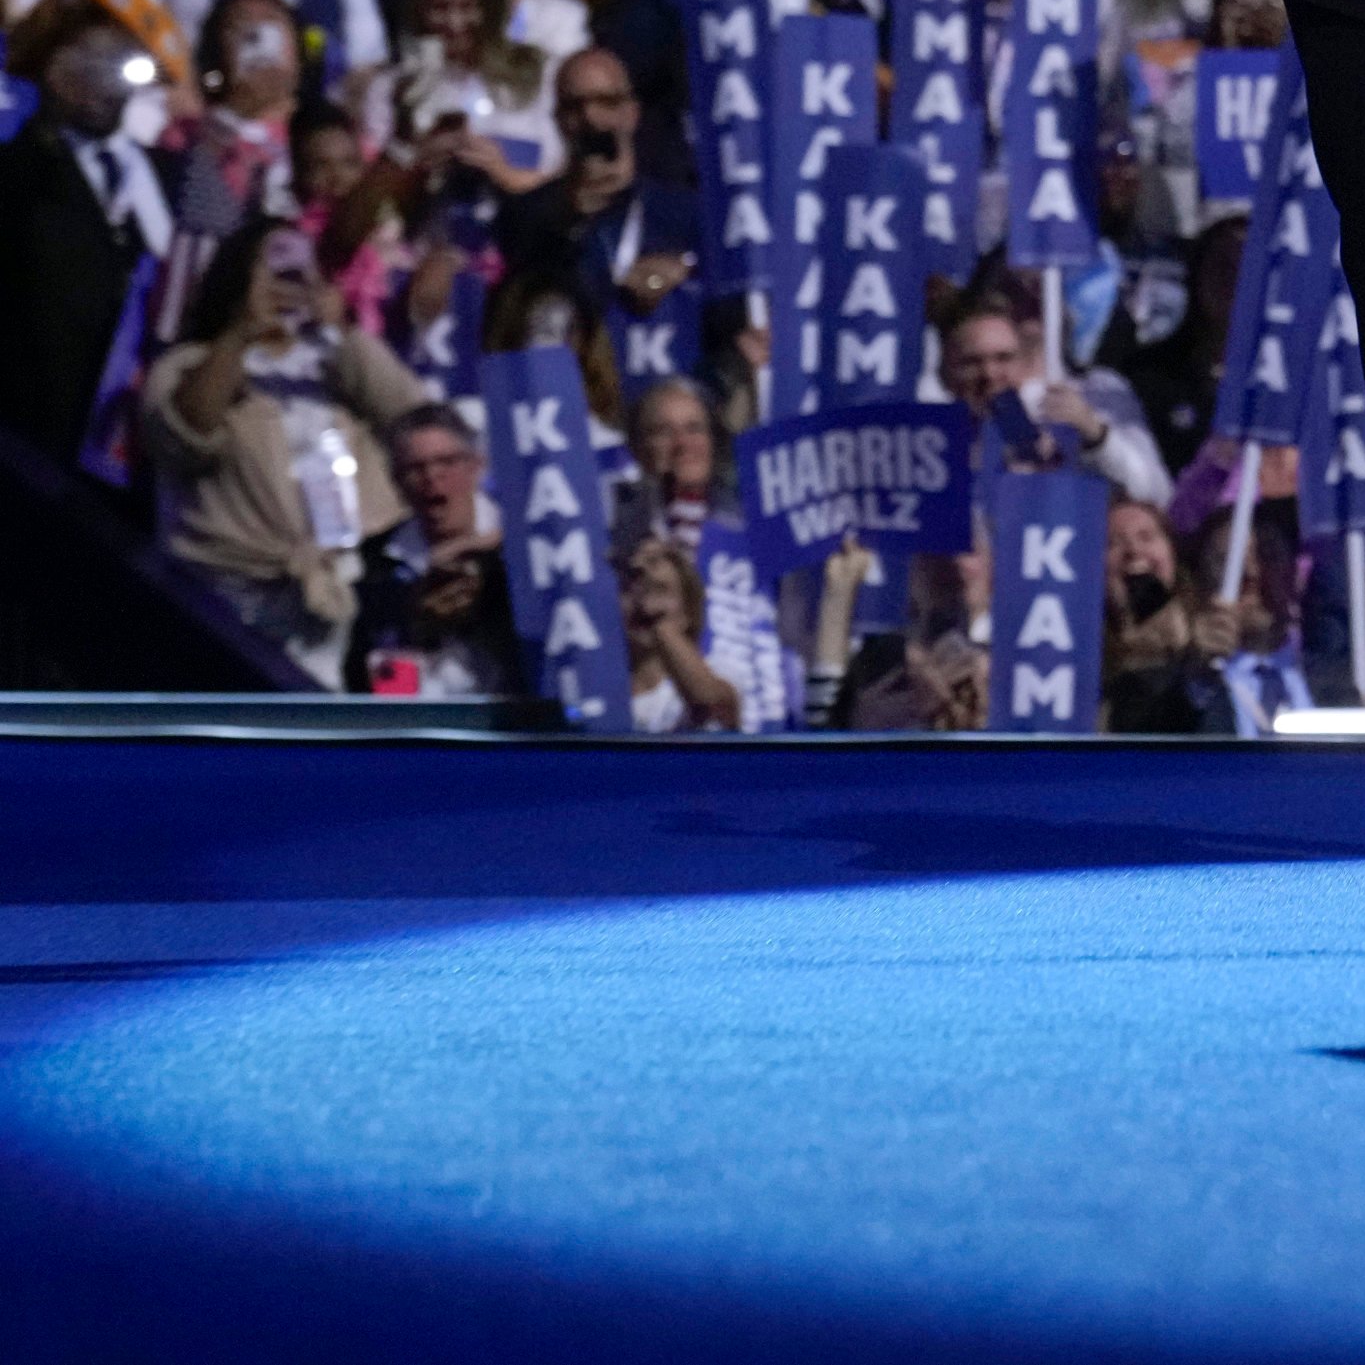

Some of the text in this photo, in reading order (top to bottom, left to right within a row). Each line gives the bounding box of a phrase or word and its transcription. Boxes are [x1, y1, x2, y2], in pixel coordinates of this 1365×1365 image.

[834, 194, 897, 386] KAM
[1253, 133, 1325, 396] MALA
[512, 398, 606, 722] KAMAL
[755, 428, 950, 518] HARRIS
[784, 494, 922, 548] WALZ
[1008, 524, 1076, 716] KAM
